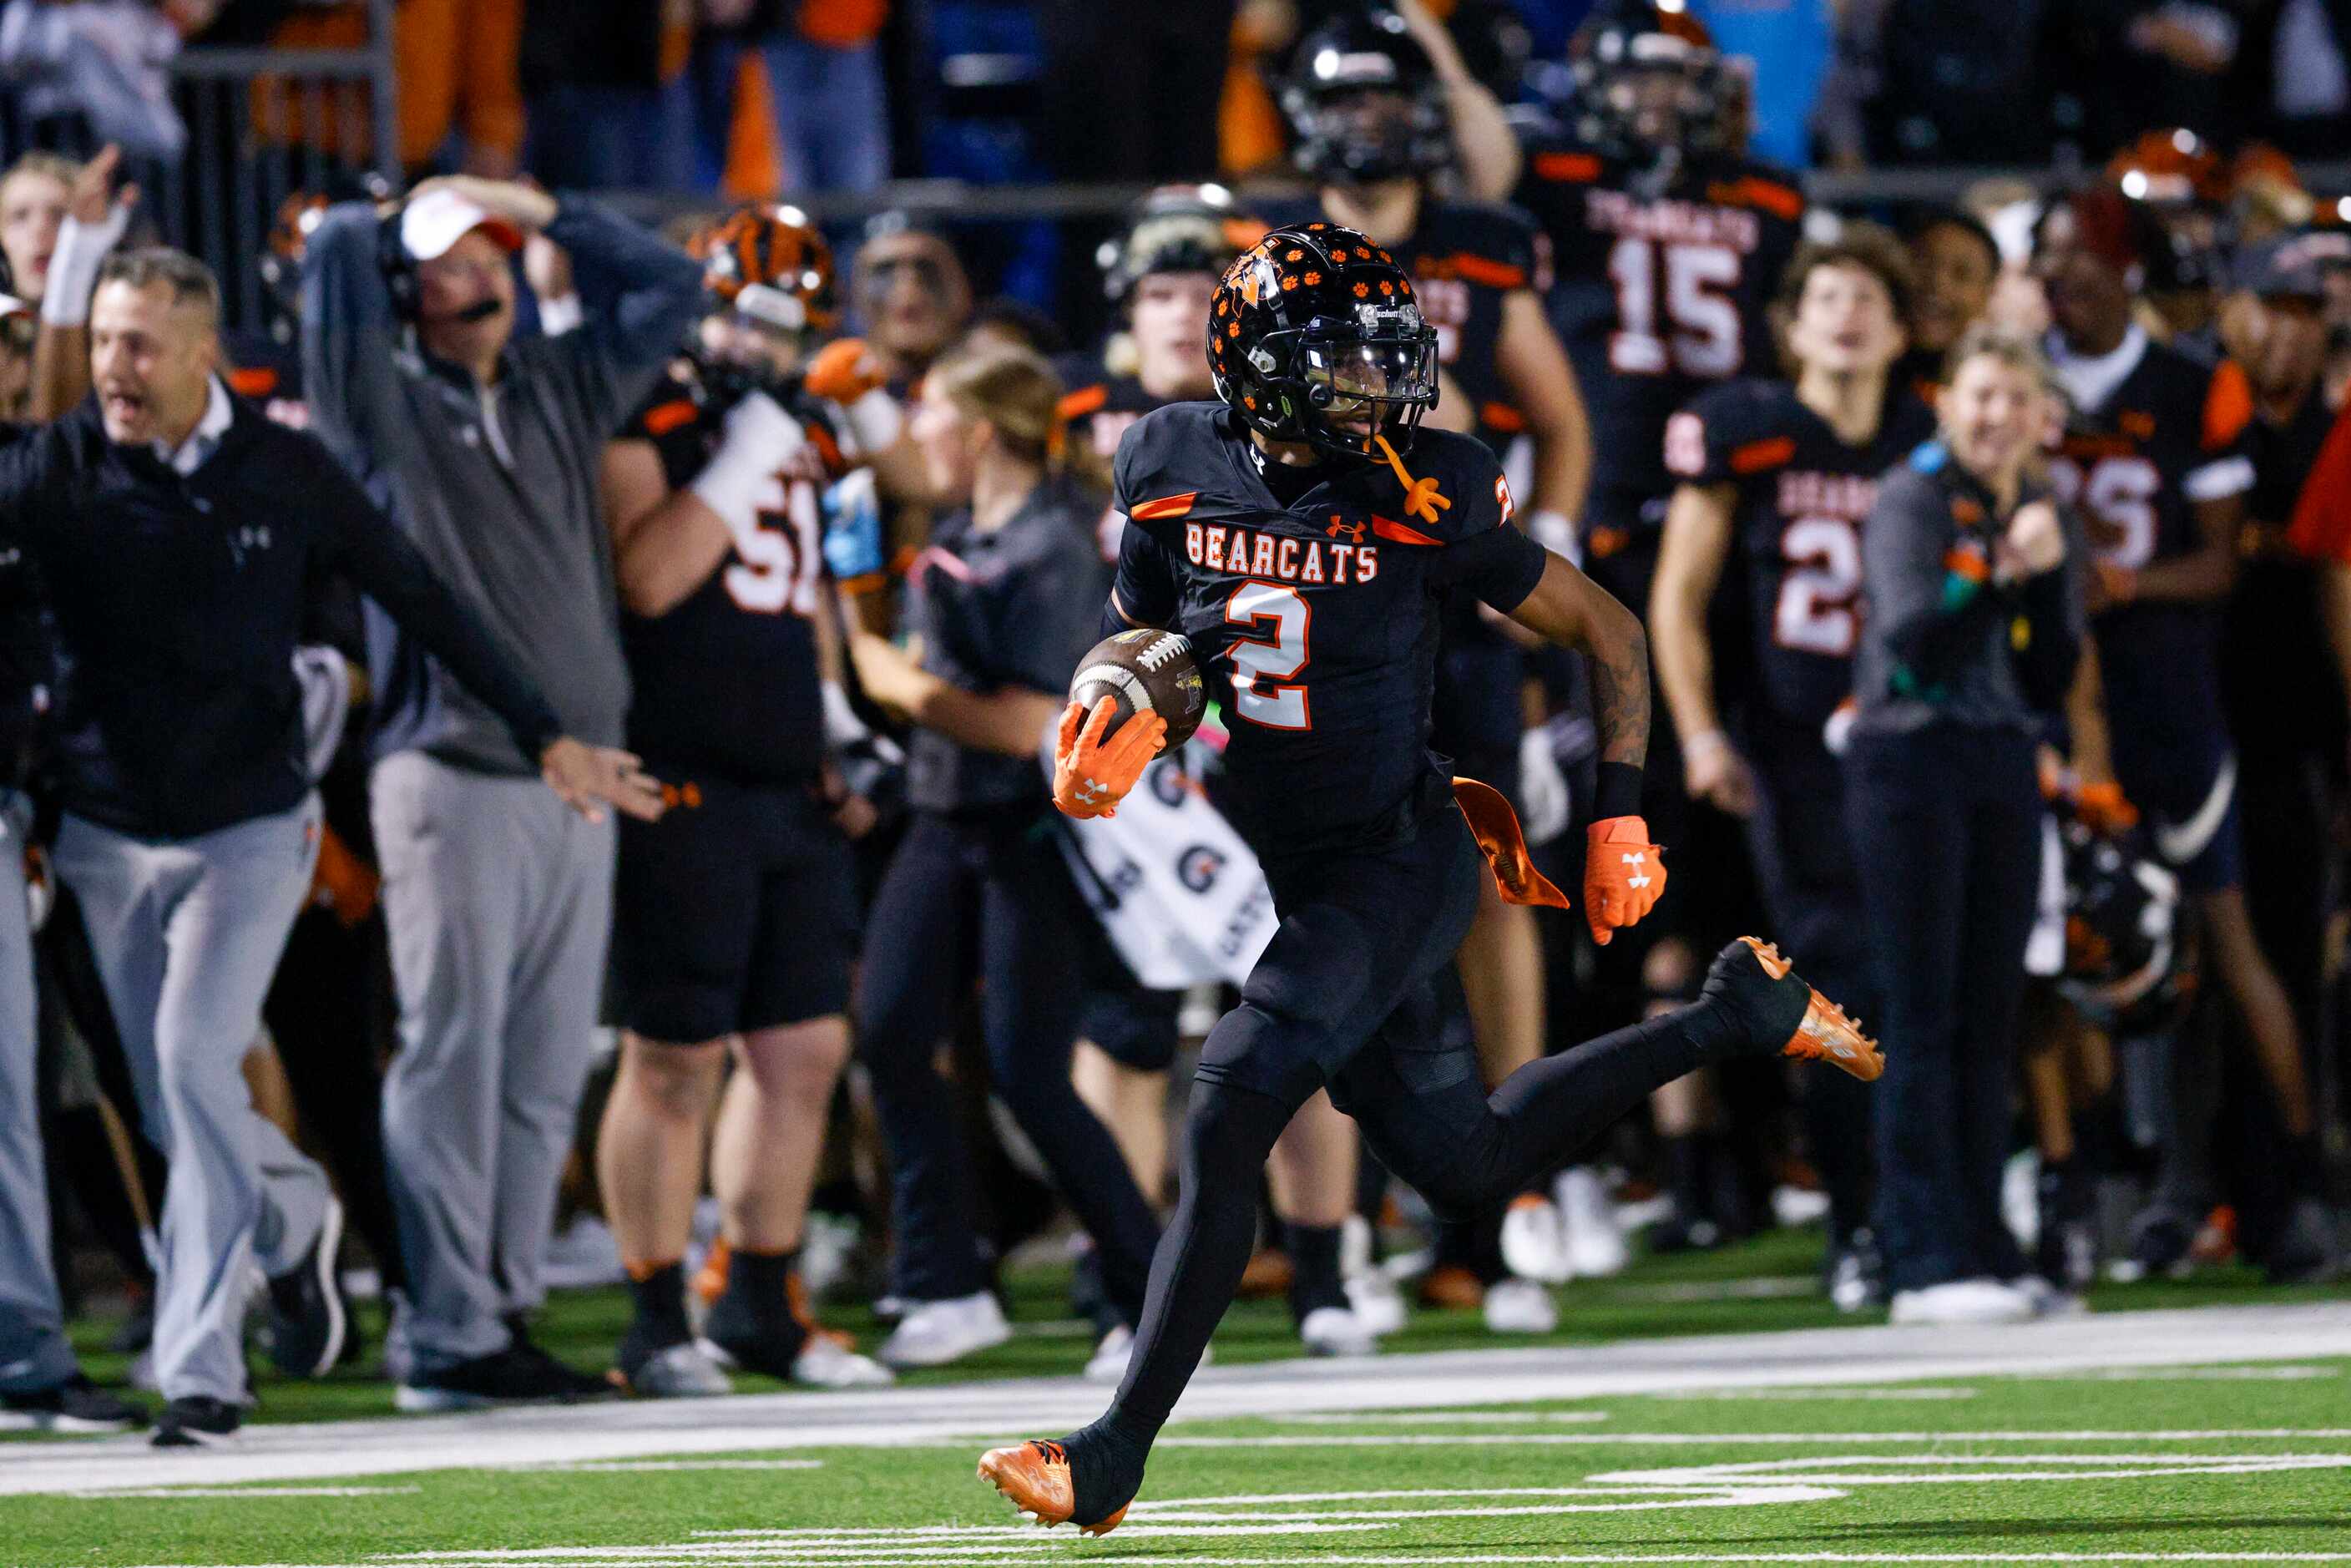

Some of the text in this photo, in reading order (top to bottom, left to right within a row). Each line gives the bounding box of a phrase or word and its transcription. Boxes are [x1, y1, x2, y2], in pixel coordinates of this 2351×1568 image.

[1608, 235, 1742, 375] 15
[723, 476, 820, 615] 51
[1186, 521, 1378, 584] BEARCATS
[1225, 579, 1313, 731] 2
